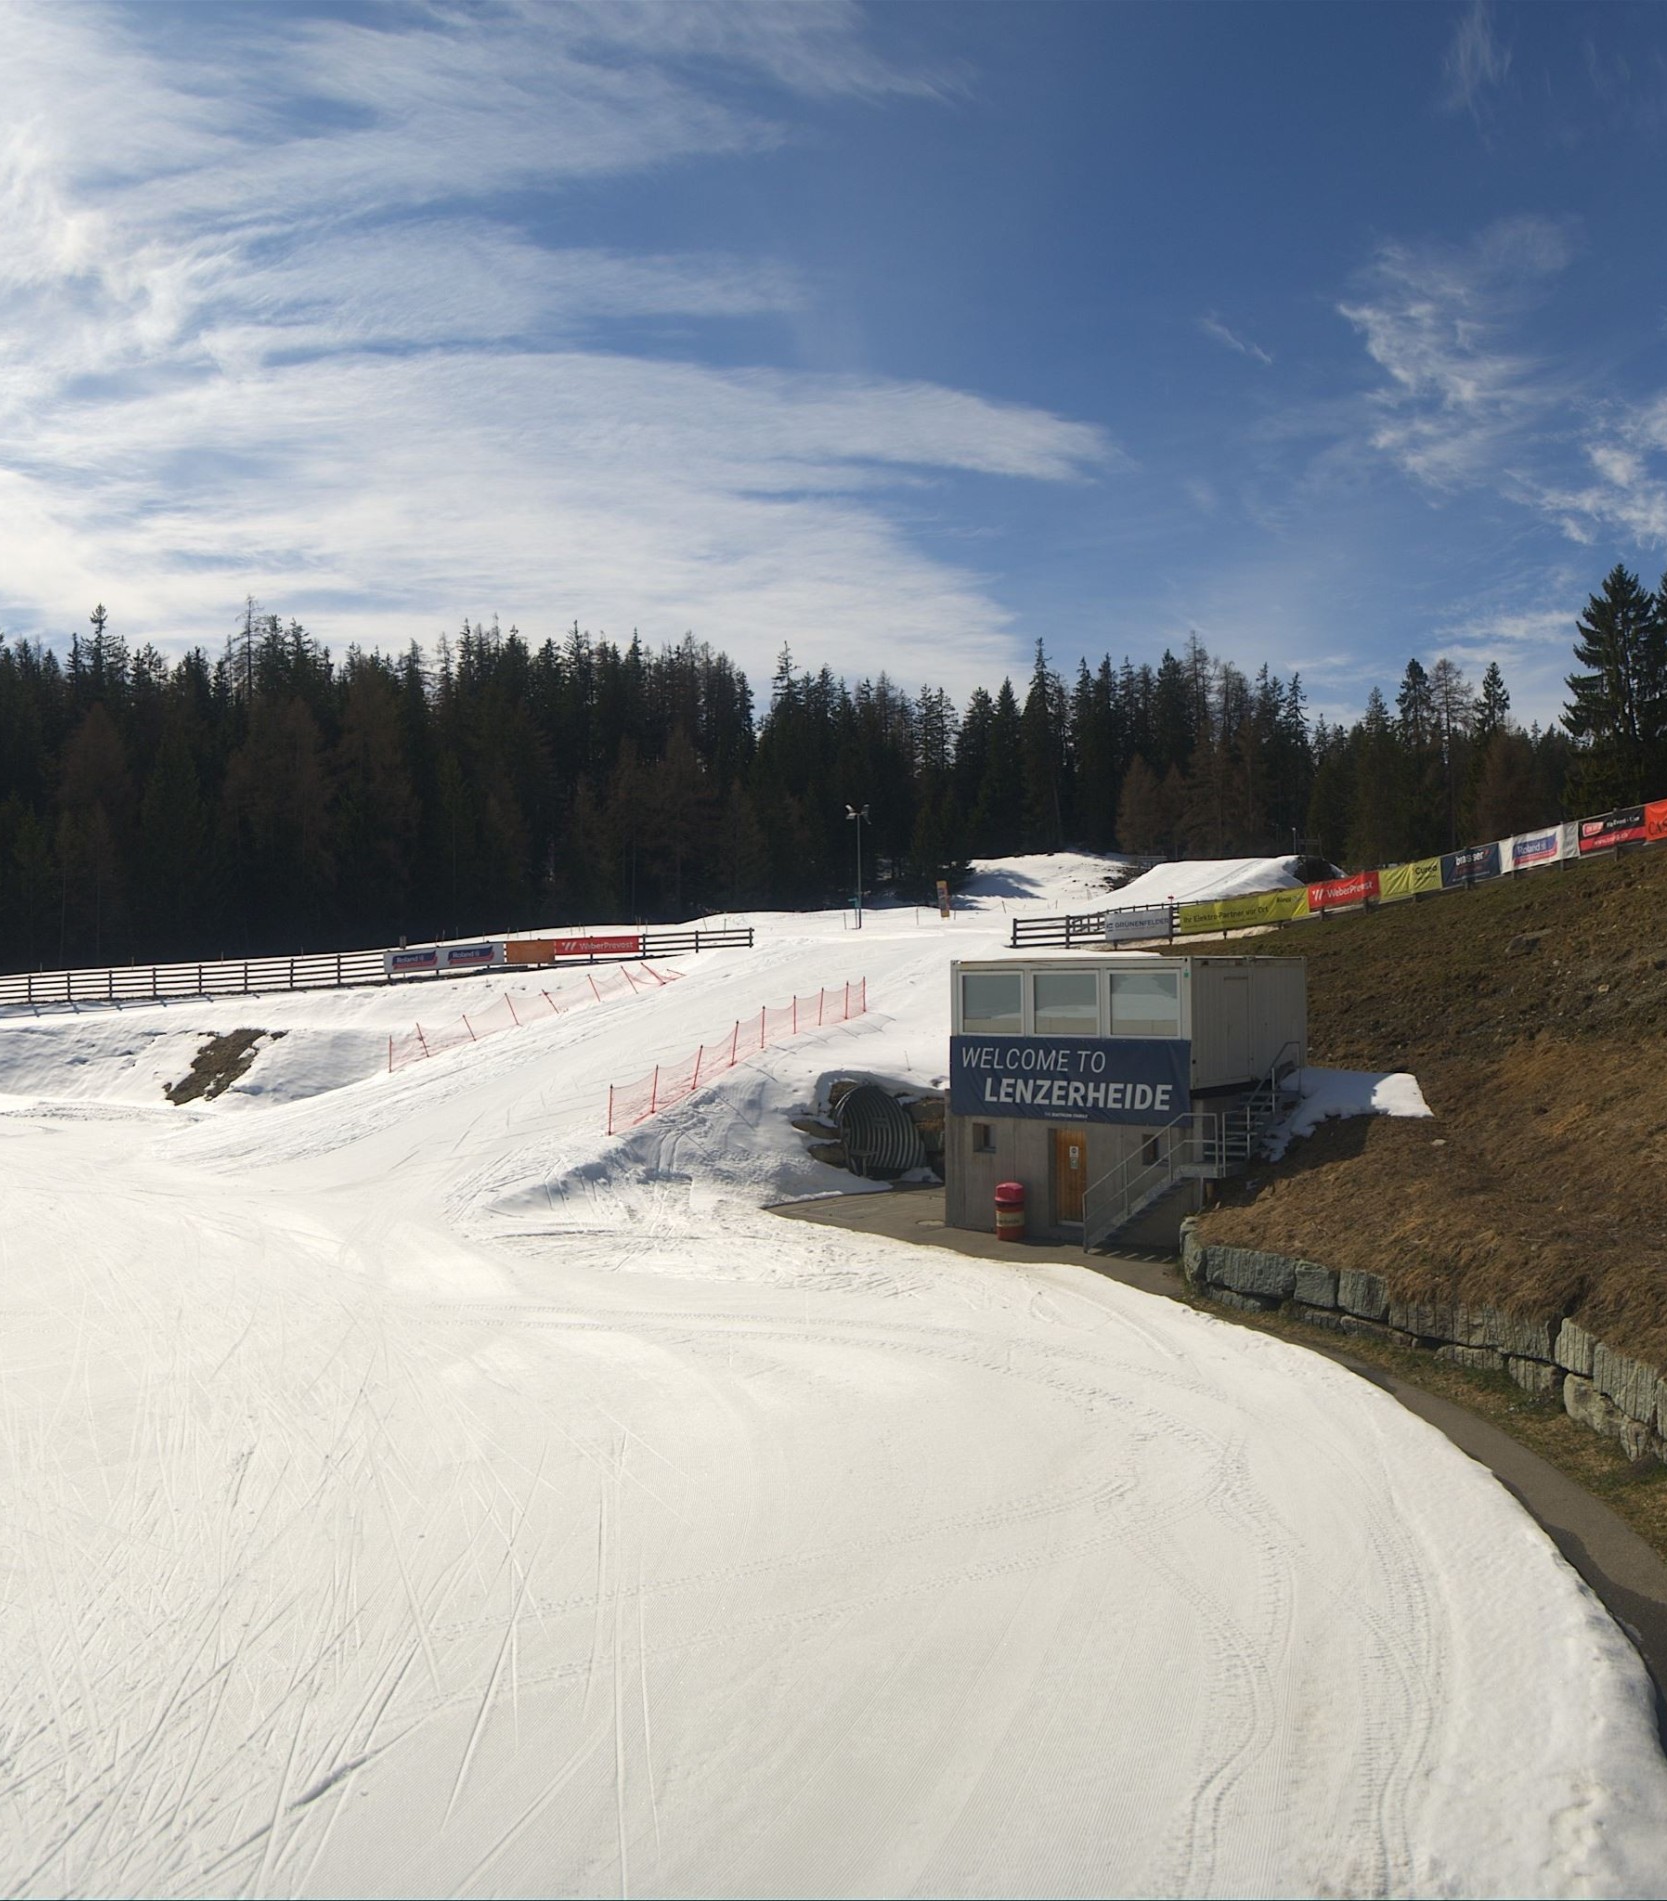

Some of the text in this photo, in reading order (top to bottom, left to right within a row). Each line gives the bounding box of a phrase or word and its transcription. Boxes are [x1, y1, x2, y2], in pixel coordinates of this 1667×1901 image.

[1115, 917, 1169, 929] GRÜNENFELDER
[1194, 910, 1243, 922] Elektro-Partner
[1258, 906, 1268, 914] Ort
[962, 1047, 1105, 1072] WELCOME TO
[984, 1078, 1173, 1110] LENZERHEIDE
